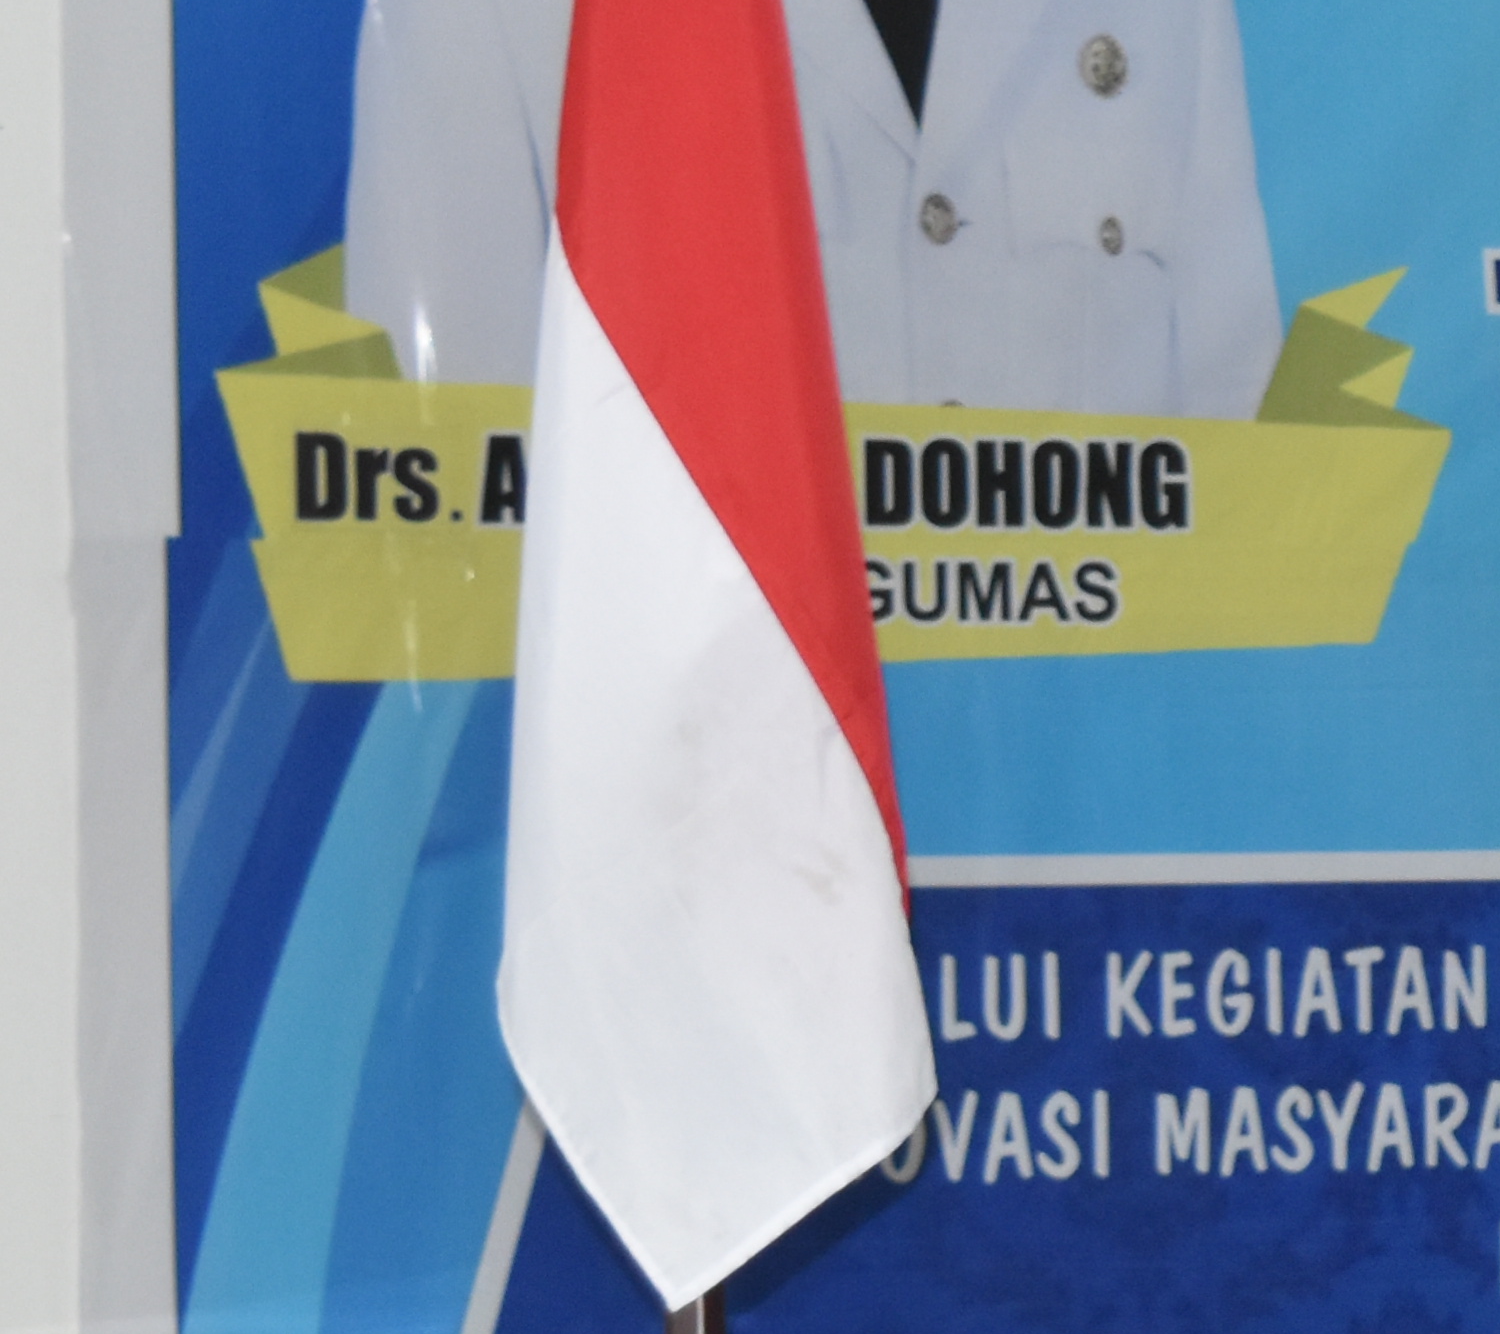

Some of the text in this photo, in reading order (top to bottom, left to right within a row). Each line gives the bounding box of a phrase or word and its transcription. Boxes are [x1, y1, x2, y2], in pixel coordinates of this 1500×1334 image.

[863, 437, 1192, 533] DOHONG
[865, 559, 1122, 624] GUMAS
[1106, 943, 1488, 1041] KEGIATAN
